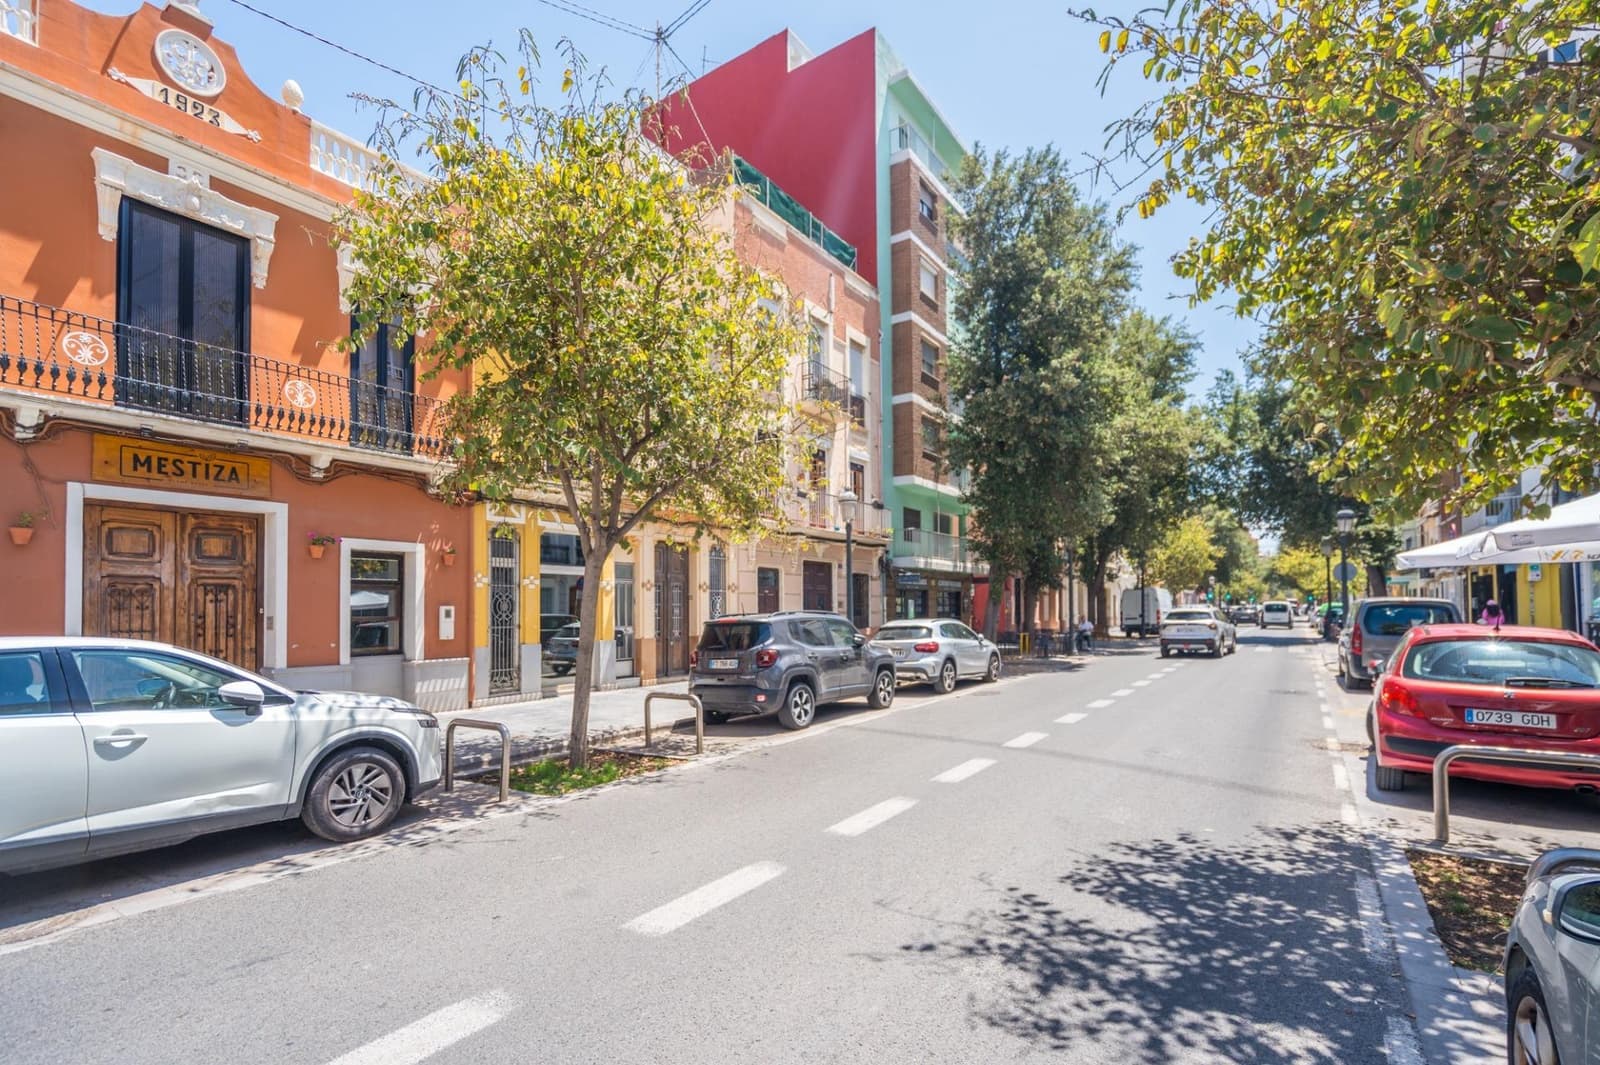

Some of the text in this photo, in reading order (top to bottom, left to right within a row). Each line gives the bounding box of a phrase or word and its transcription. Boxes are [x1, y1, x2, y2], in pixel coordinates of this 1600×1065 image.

[159, 87, 221, 127] 1923
[132, 453, 240, 483] MESTIZA
[1475, 711, 1551, 727] 0739 GDH
